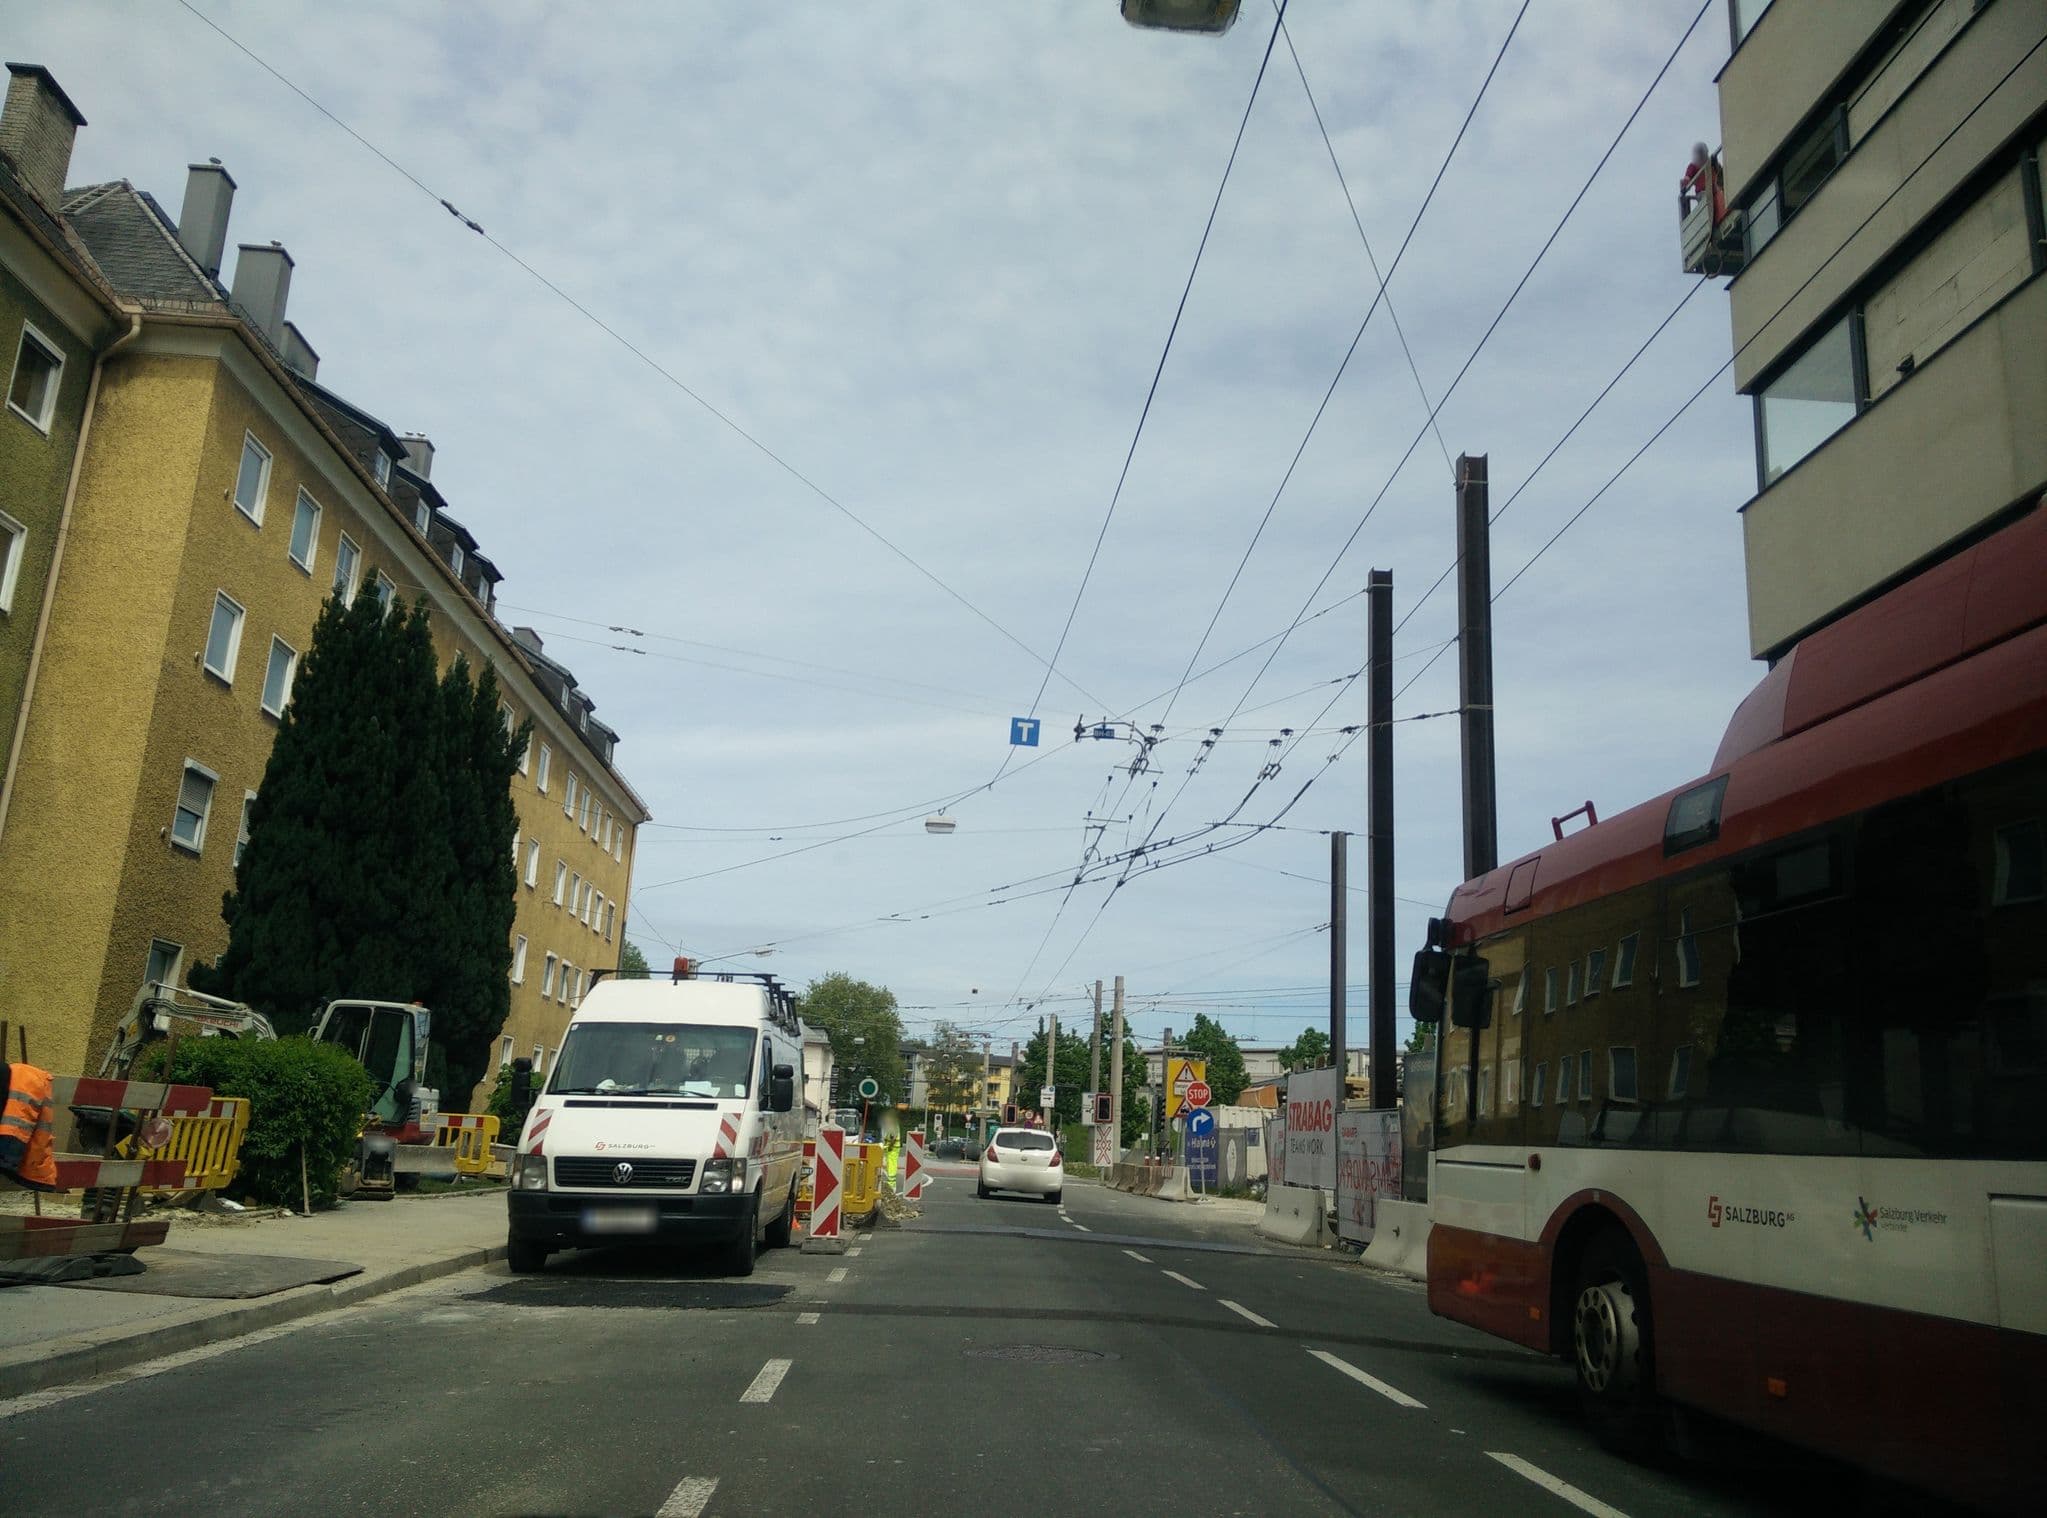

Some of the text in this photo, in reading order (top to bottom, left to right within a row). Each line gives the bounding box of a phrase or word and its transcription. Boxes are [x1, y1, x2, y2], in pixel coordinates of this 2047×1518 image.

[1189, 1089, 1208, 1100] STOP
[1289, 1099, 1332, 1132] STRABAG
[1725, 1206, 1785, 1228] SALZBURG
[1880, 1206, 1948, 1224] Salzburg Verkehr
